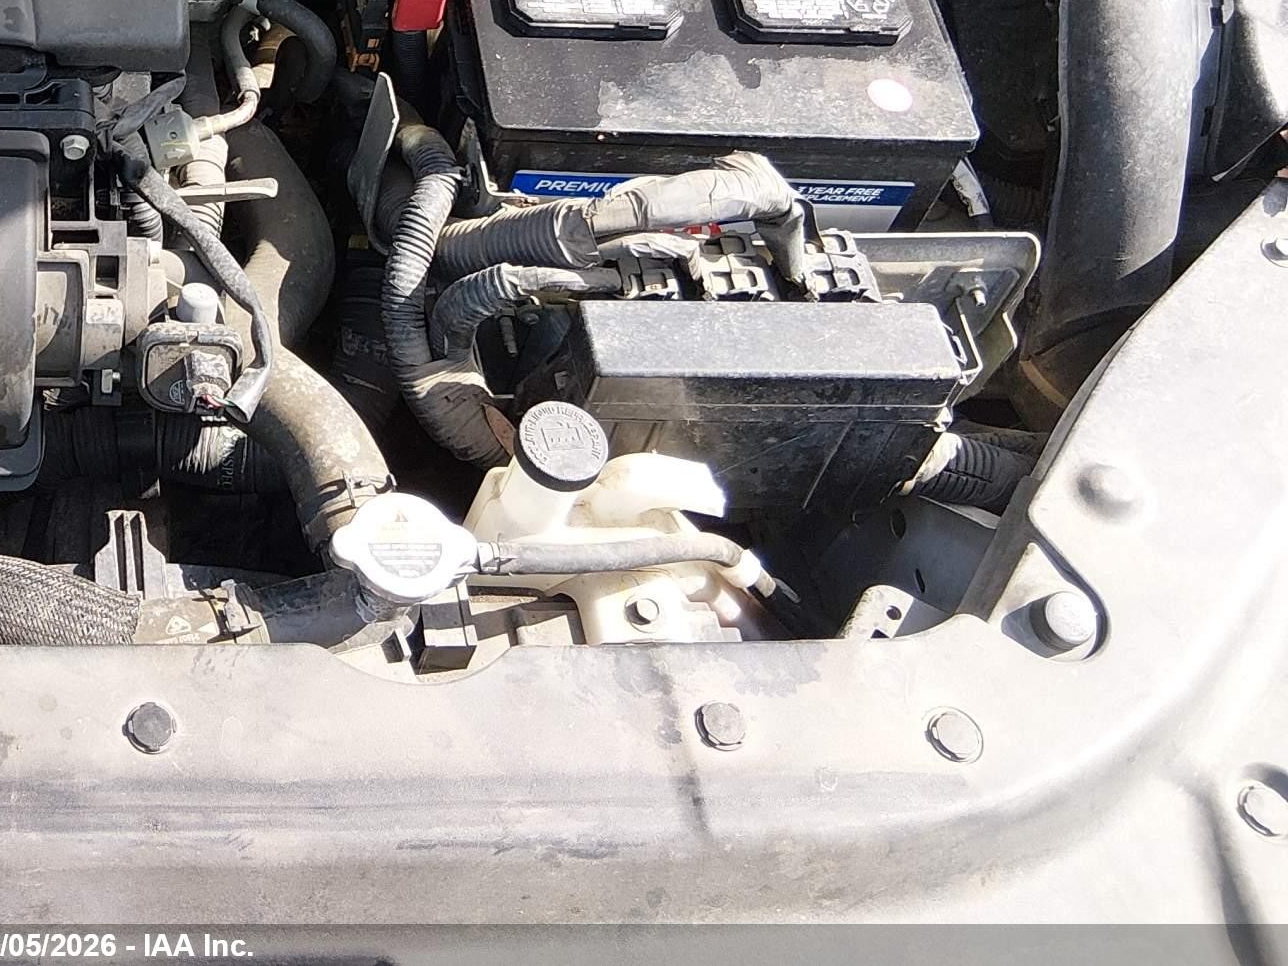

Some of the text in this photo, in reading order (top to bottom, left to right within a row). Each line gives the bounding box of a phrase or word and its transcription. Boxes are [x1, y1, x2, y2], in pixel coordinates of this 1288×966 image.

[534, 179, 612, 193] PREMIU
[808, 186, 845, 195] YEAR
[845, 187, 884, 196] FREE
